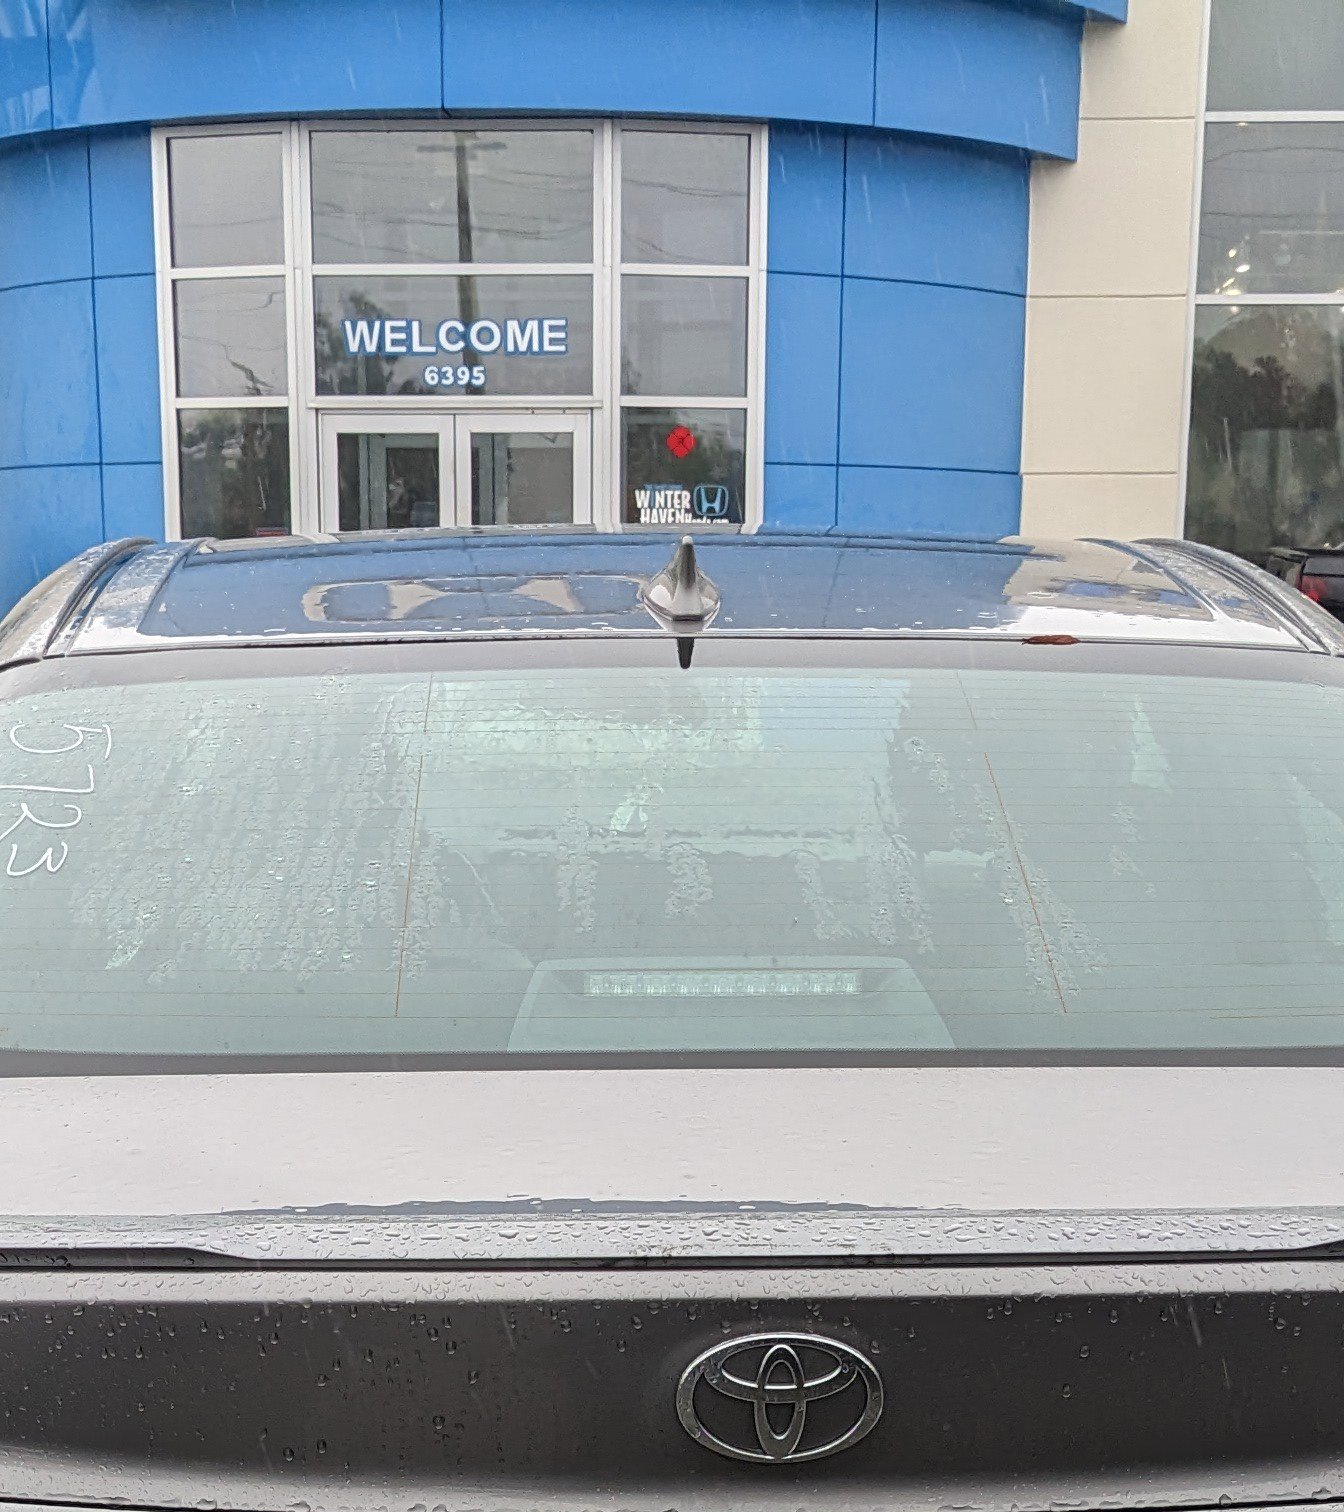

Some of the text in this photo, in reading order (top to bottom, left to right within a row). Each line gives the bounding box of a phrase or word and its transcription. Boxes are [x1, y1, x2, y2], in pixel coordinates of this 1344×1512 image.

[342, 319, 568, 354] WELCOME
[424, 365, 486, 386] 6395
[634, 488, 692, 510] WINTER
